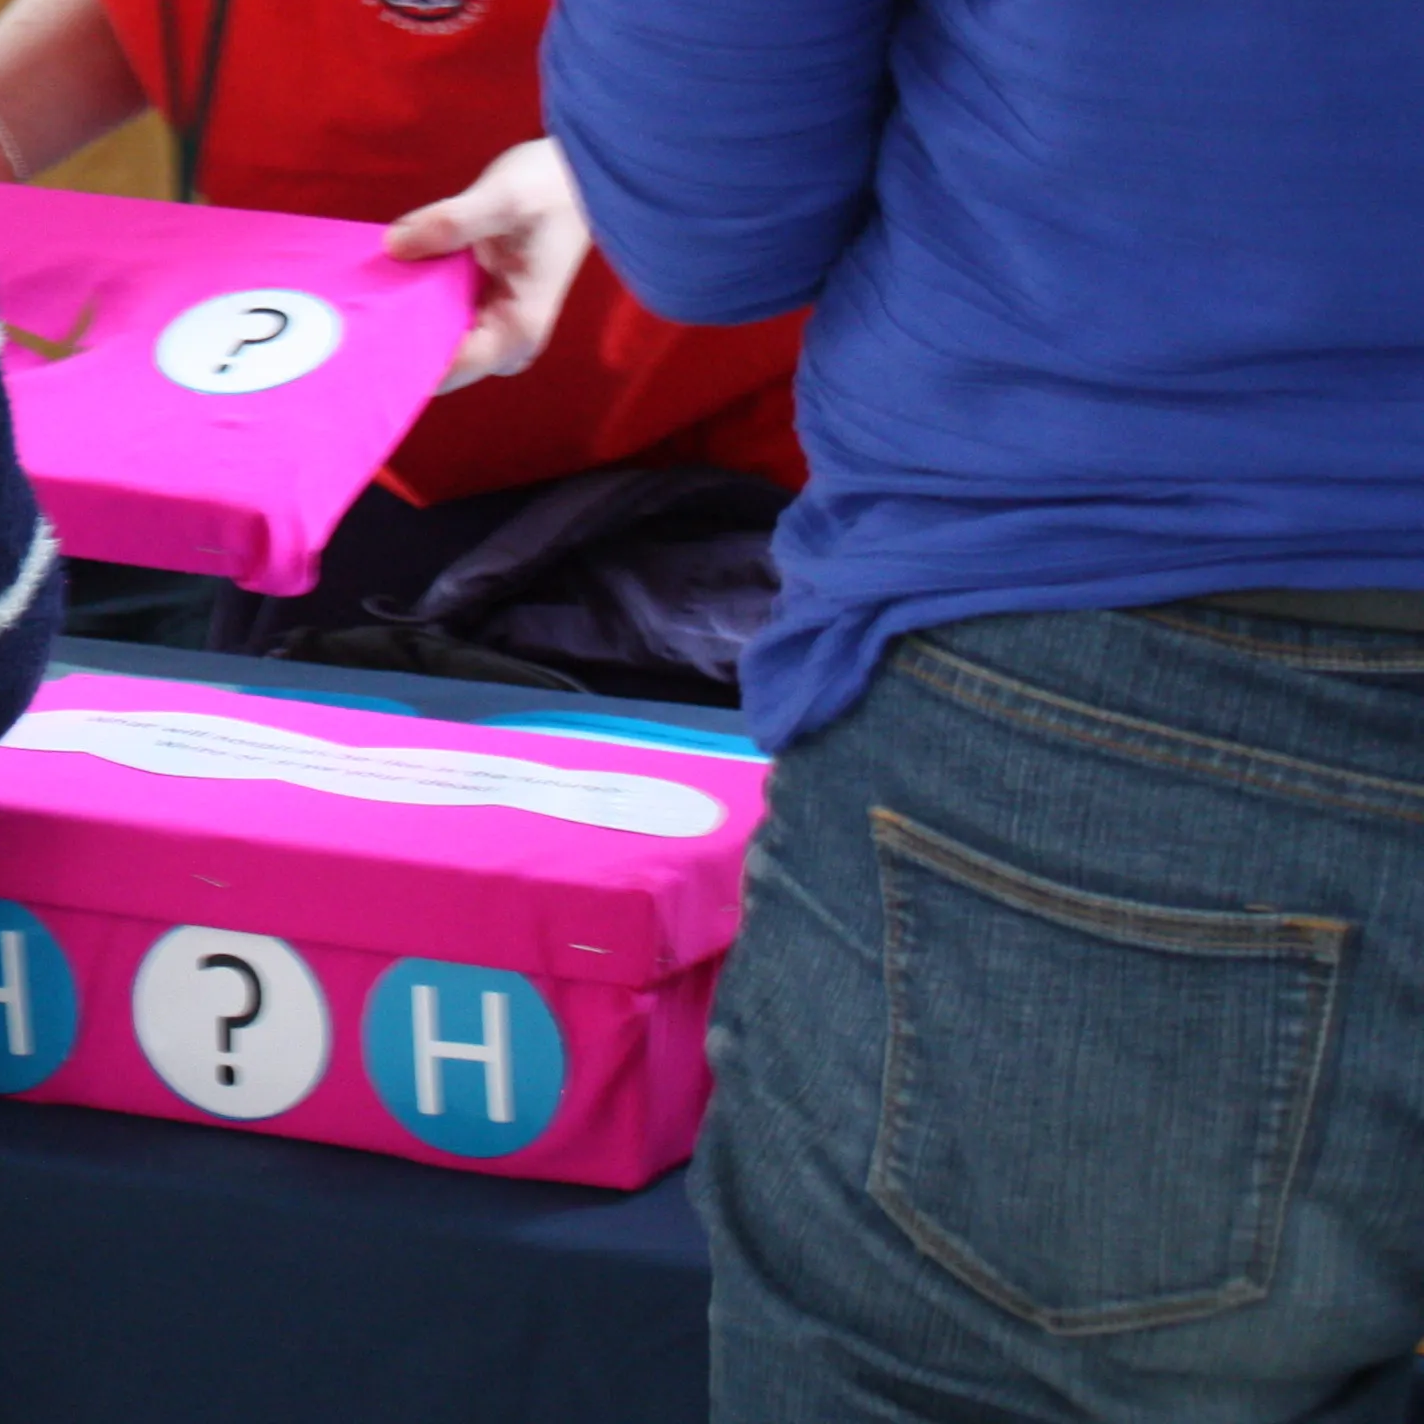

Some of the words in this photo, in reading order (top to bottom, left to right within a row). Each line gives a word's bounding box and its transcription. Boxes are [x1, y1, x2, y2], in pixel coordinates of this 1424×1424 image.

[212, 307, 289, 375] ?
[199, 953, 263, 1087] ?
[411, 985, 516, 1123] H
